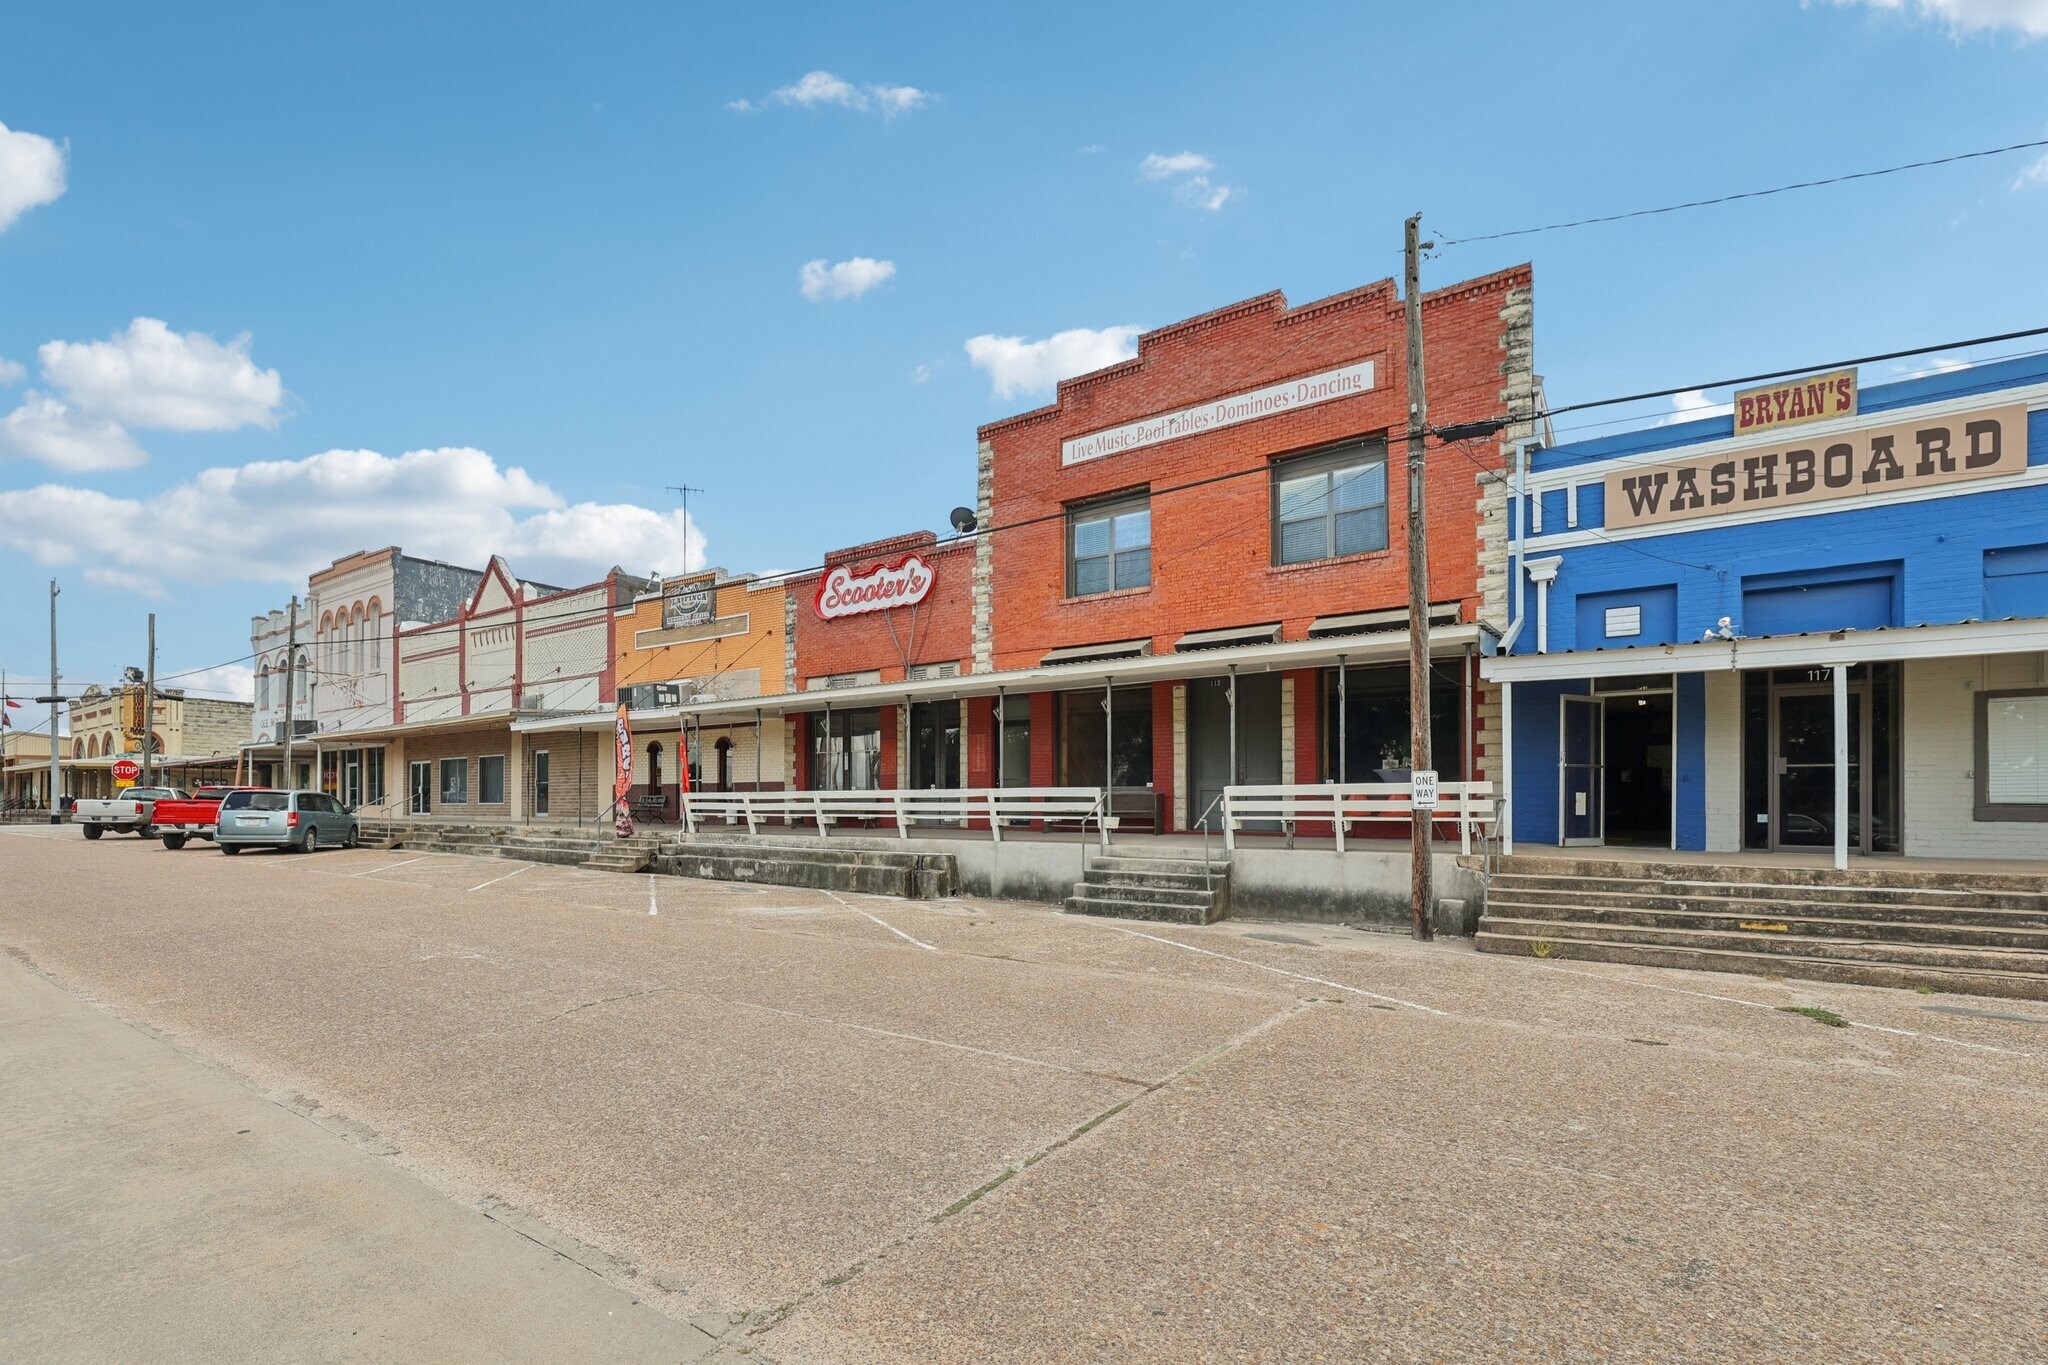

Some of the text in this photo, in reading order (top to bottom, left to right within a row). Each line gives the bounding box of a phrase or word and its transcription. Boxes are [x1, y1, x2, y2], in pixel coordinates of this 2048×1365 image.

[1072, 372, 1362, 460] Live Music Pool Tables Dominoes Dancing
[1739, 377, 1852, 429] BRYAN'S
[1621, 418, 2002, 517] WASHBOARD
[825, 566, 927, 610] Scooter's
[1807, 669, 1831, 682] 117
[113, 765, 138, 775] STOP
[1415, 776, 1435, 786] ONE
[1415, 788, 1435, 798] WAY
